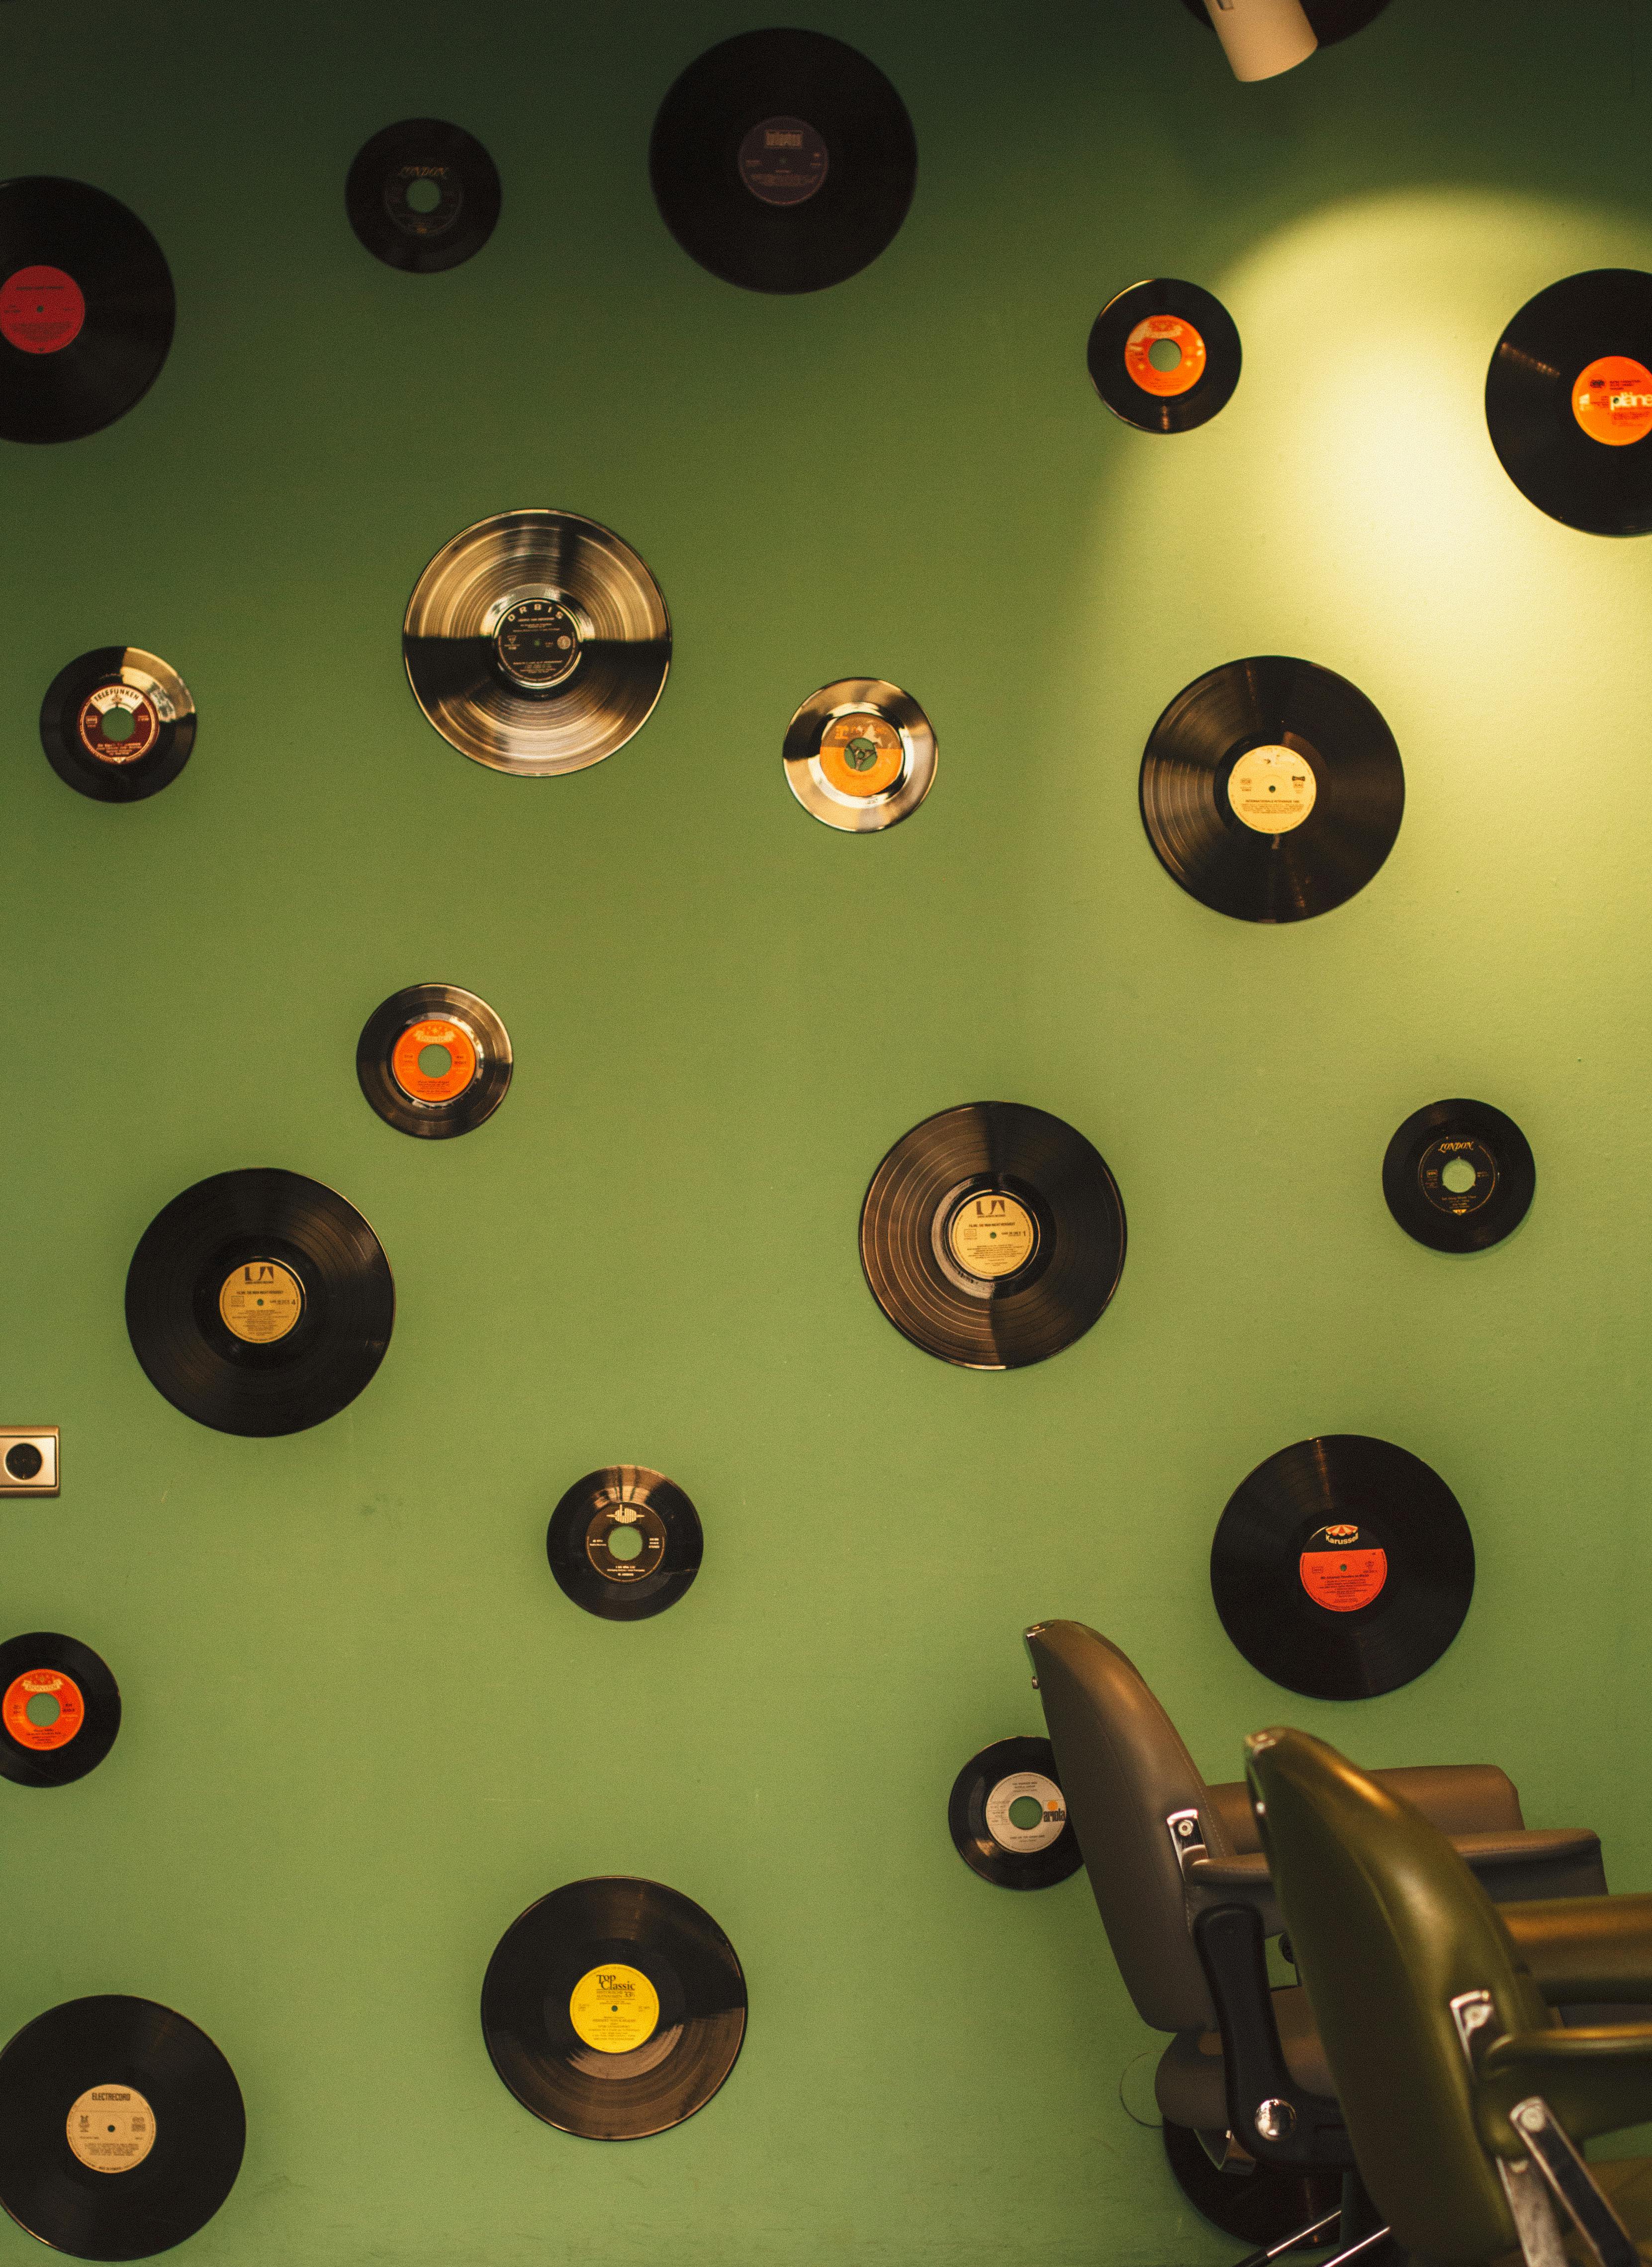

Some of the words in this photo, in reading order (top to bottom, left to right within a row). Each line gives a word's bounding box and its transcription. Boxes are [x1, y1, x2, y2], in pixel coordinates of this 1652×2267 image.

[94, 688, 139, 702] TELEFUNKEN
[1438, 1141, 1474, 1153] LONDON
[1325, 1532, 1359, 1545] Karussell
[1043, 1808, 1066, 1822] ariola
[600, 1981, 636, 1990] Classic
[92, 2092, 131, 2101] ELECTRECORD
